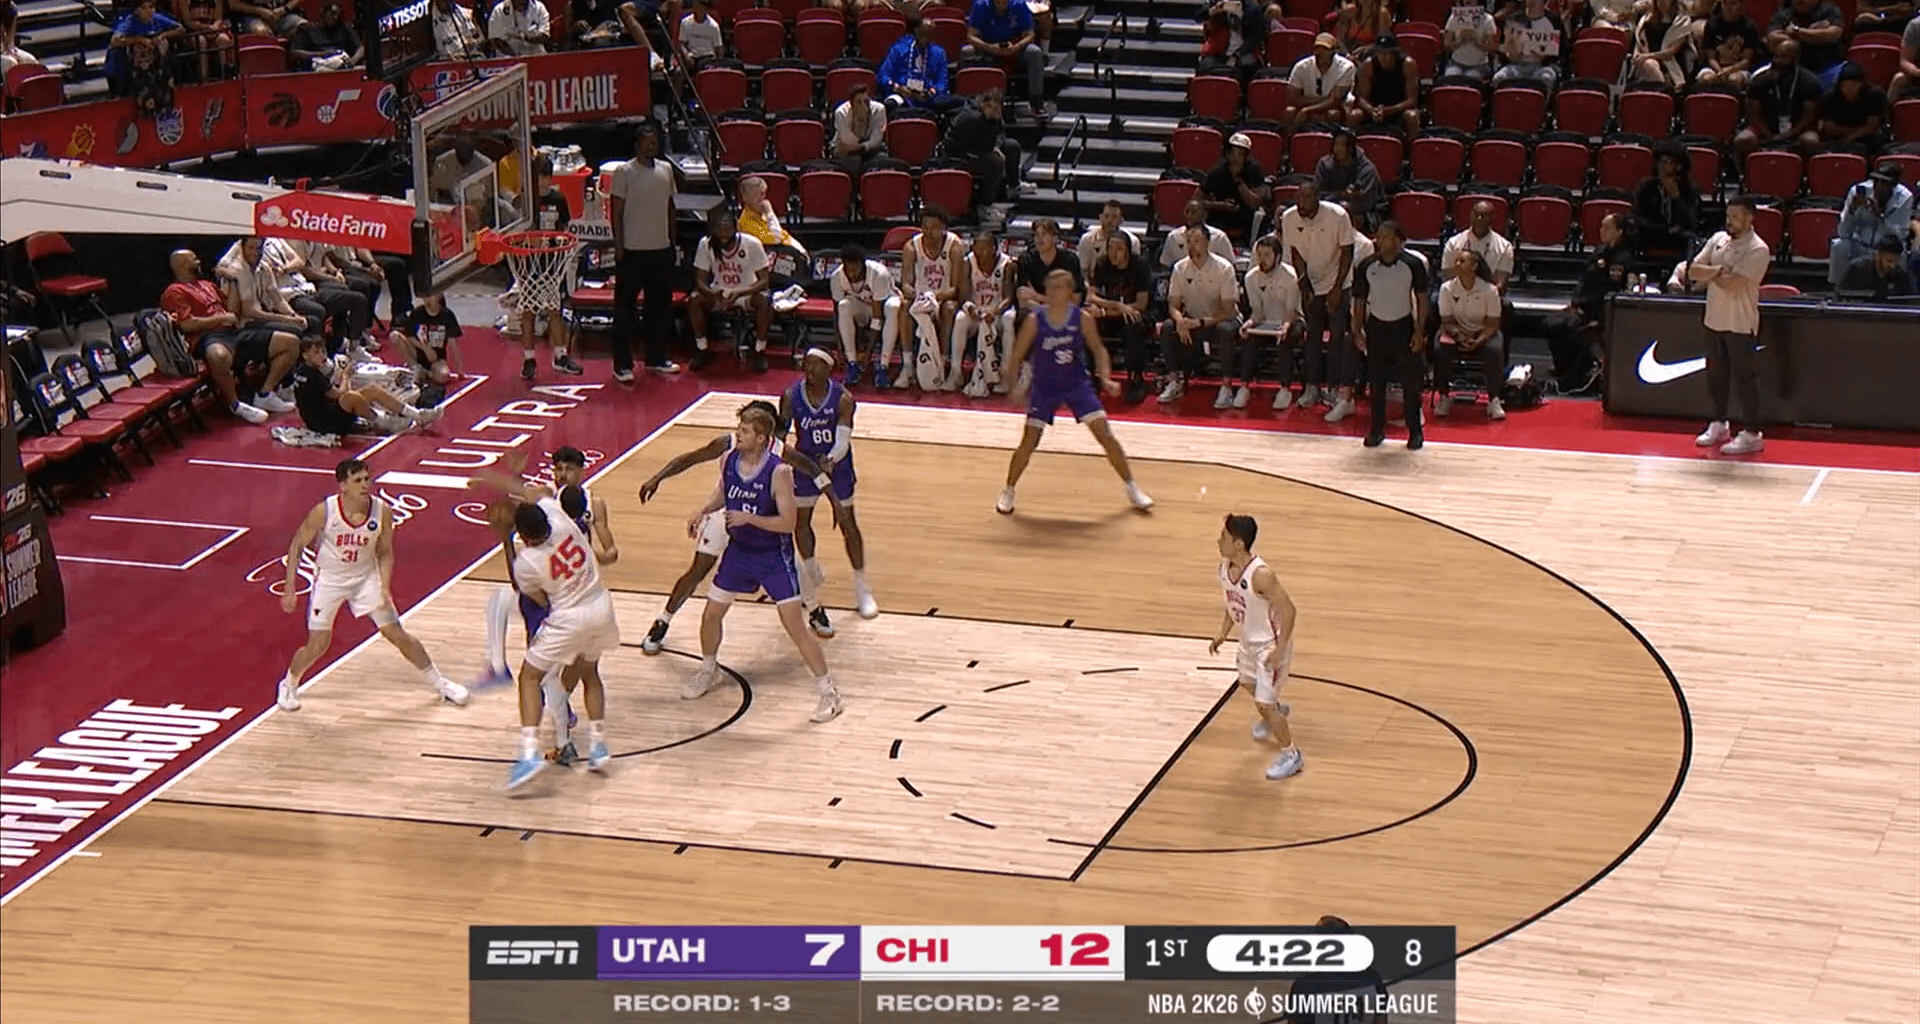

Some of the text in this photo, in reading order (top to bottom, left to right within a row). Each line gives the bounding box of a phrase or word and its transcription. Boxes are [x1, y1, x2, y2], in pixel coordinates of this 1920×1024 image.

[393, 0, 429, 28] TISSOT
[552, 75, 619, 114] LEAGUE
[418, 383, 605, 468] ULTRA
[812, 429, 833, 445] 60
[336, 533, 369, 547] BULLS
[342, 550, 358, 562] 31
[549, 535, 586, 580] 45
[0, 698, 243, 795] LEAGUE
